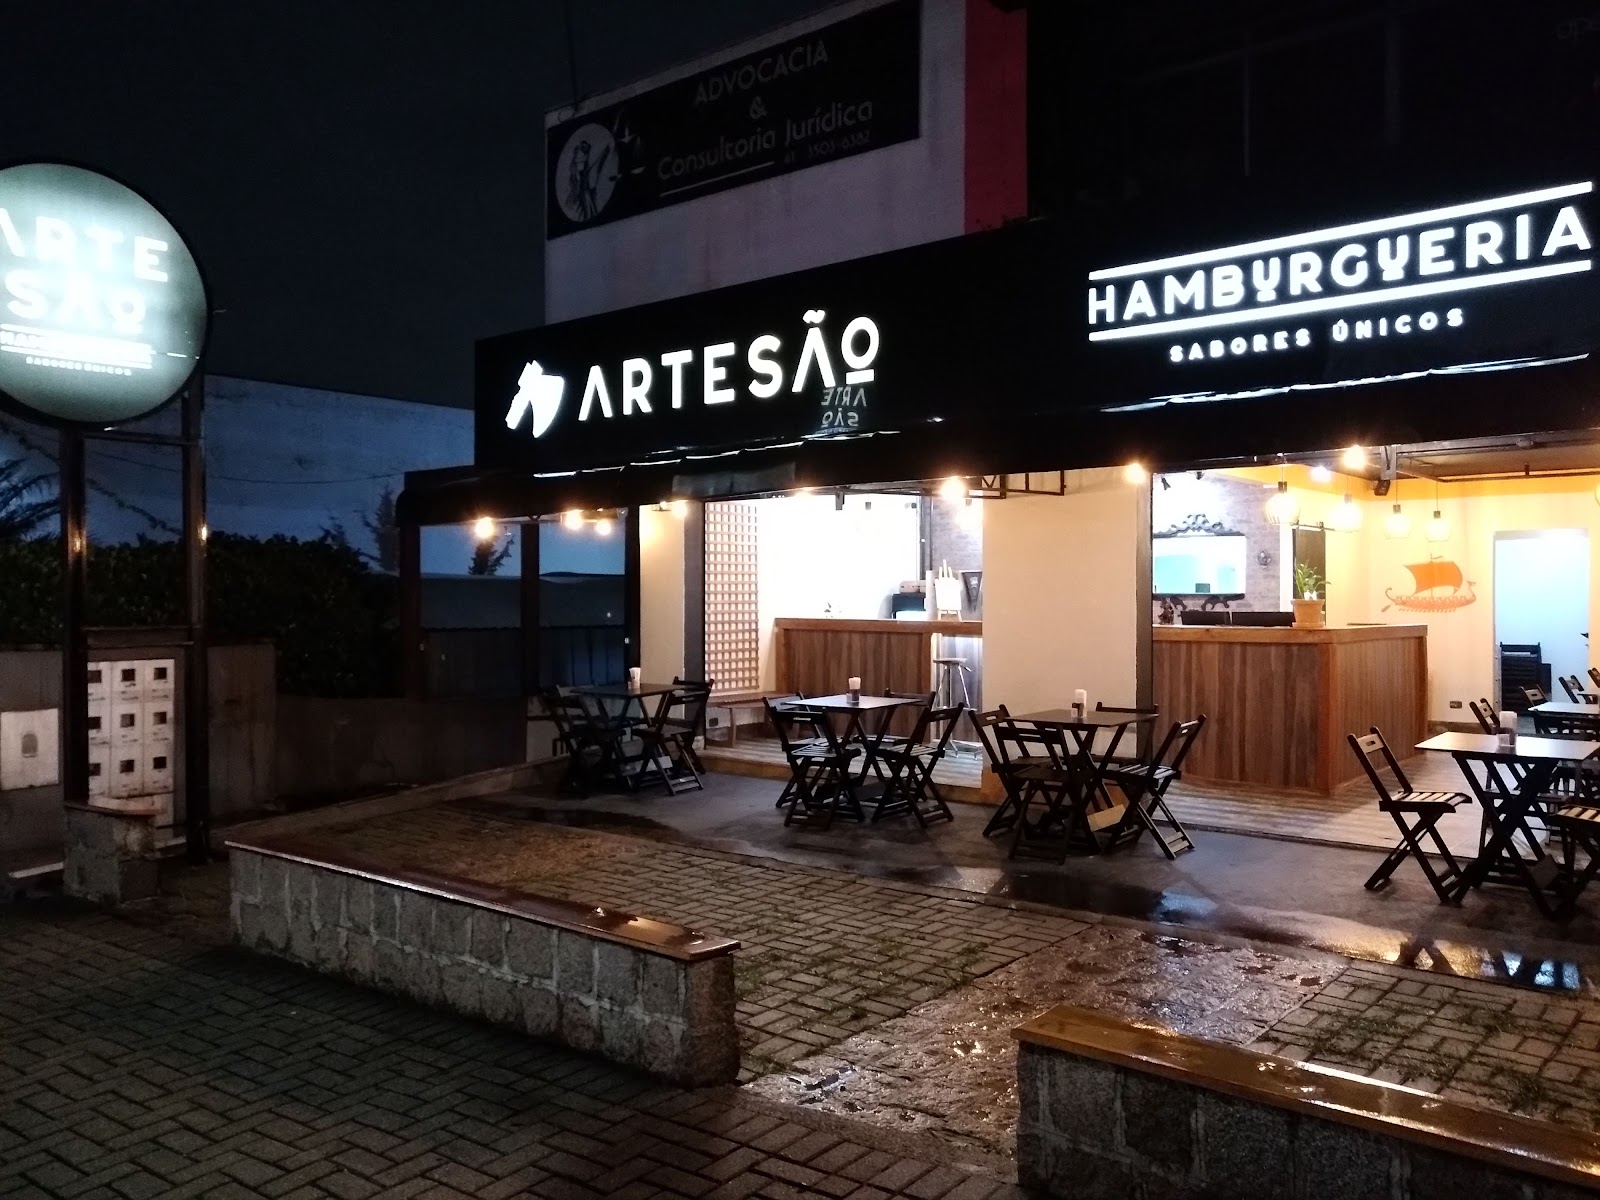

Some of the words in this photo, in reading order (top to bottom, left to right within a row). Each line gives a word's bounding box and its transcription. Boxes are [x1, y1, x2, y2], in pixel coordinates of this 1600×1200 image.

[693, 39, 829, 106] ADVOCACIA
[749, 96, 769, 121] &
[657, 127, 776, 180] Consultoria
[784, 100, 873, 147] Jurídica
[1088, 206, 1591, 325] HAMBURGUERIA
[578, 309, 880, 422] ARTESÃO
[1168, 328, 1311, 363] SABORES
[1332, 308, 1464, 342] ÚNICOS
